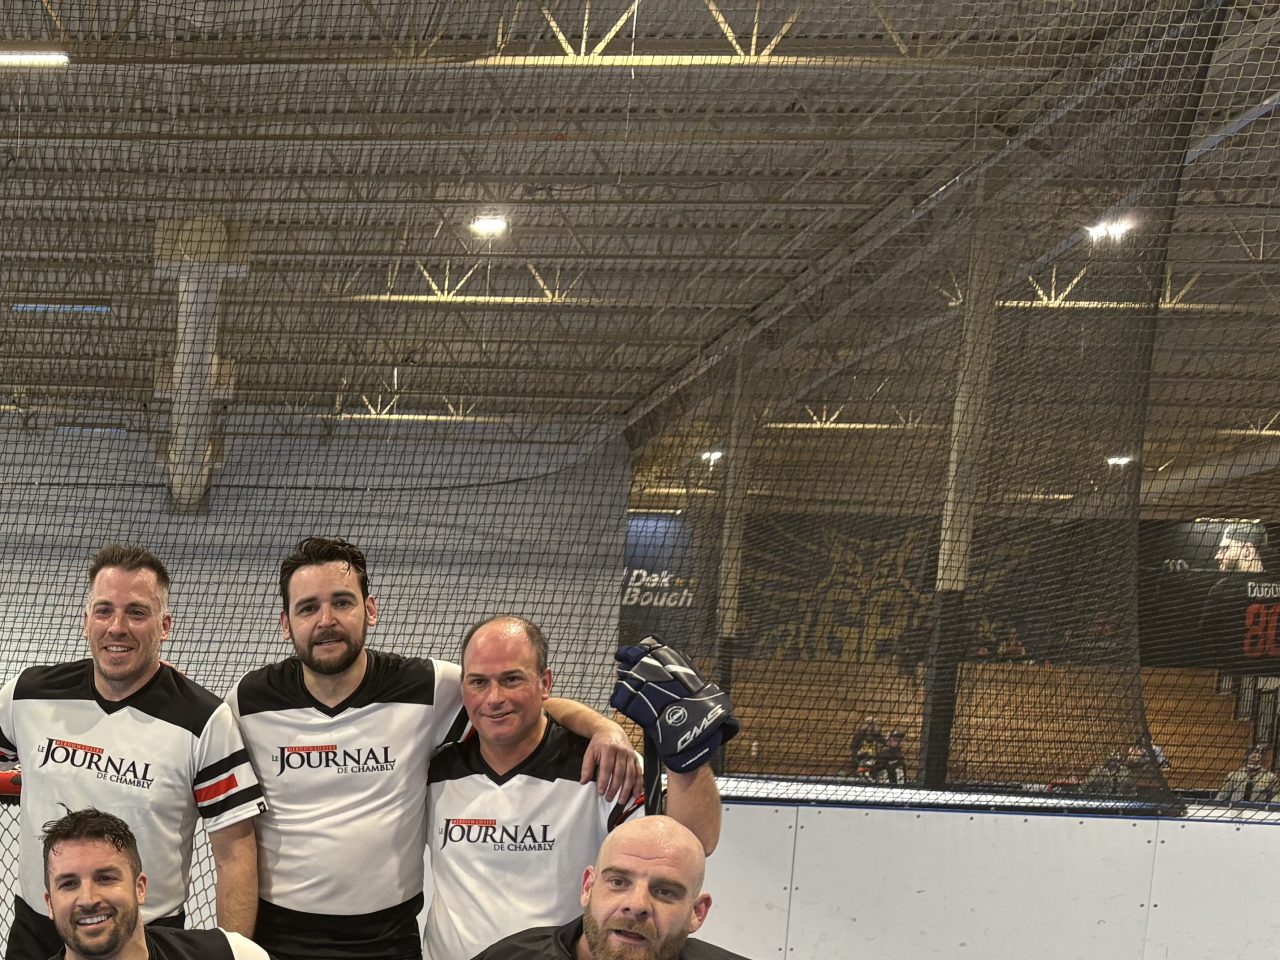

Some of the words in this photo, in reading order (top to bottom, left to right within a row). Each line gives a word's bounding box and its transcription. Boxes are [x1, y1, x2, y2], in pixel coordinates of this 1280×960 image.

[38, 745, 45, 753] LE
[39, 737, 154, 782] JOURNAL
[276, 746, 396, 777] JOURNAL
[351, 764, 395, 773] CHAMBLY
[96, 772, 108, 780] DE
[109, 775, 153, 789] CHAMBLY
[440, 818, 556, 851] JOURNAL
[507, 843, 554, 852] CHAMBLY
